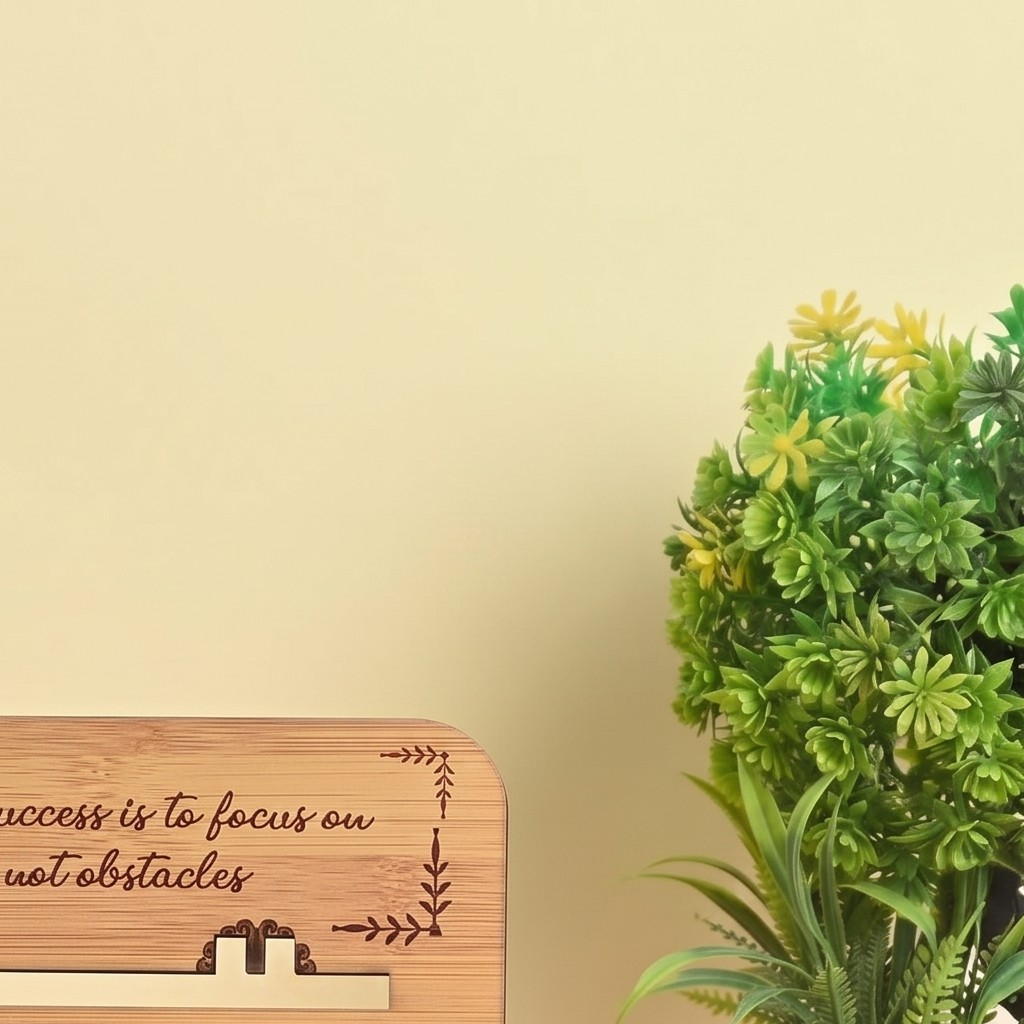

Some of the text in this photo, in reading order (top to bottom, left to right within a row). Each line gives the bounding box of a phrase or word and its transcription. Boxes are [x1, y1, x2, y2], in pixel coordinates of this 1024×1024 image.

[119, 799, 157, 831] is
[164, 791, 205, 829] to
[206, 790, 320, 842] focus
[321, 809, 375, 830] on
[5, 851, 82, 888] not
[75, 848, 254, 893] obstacles
